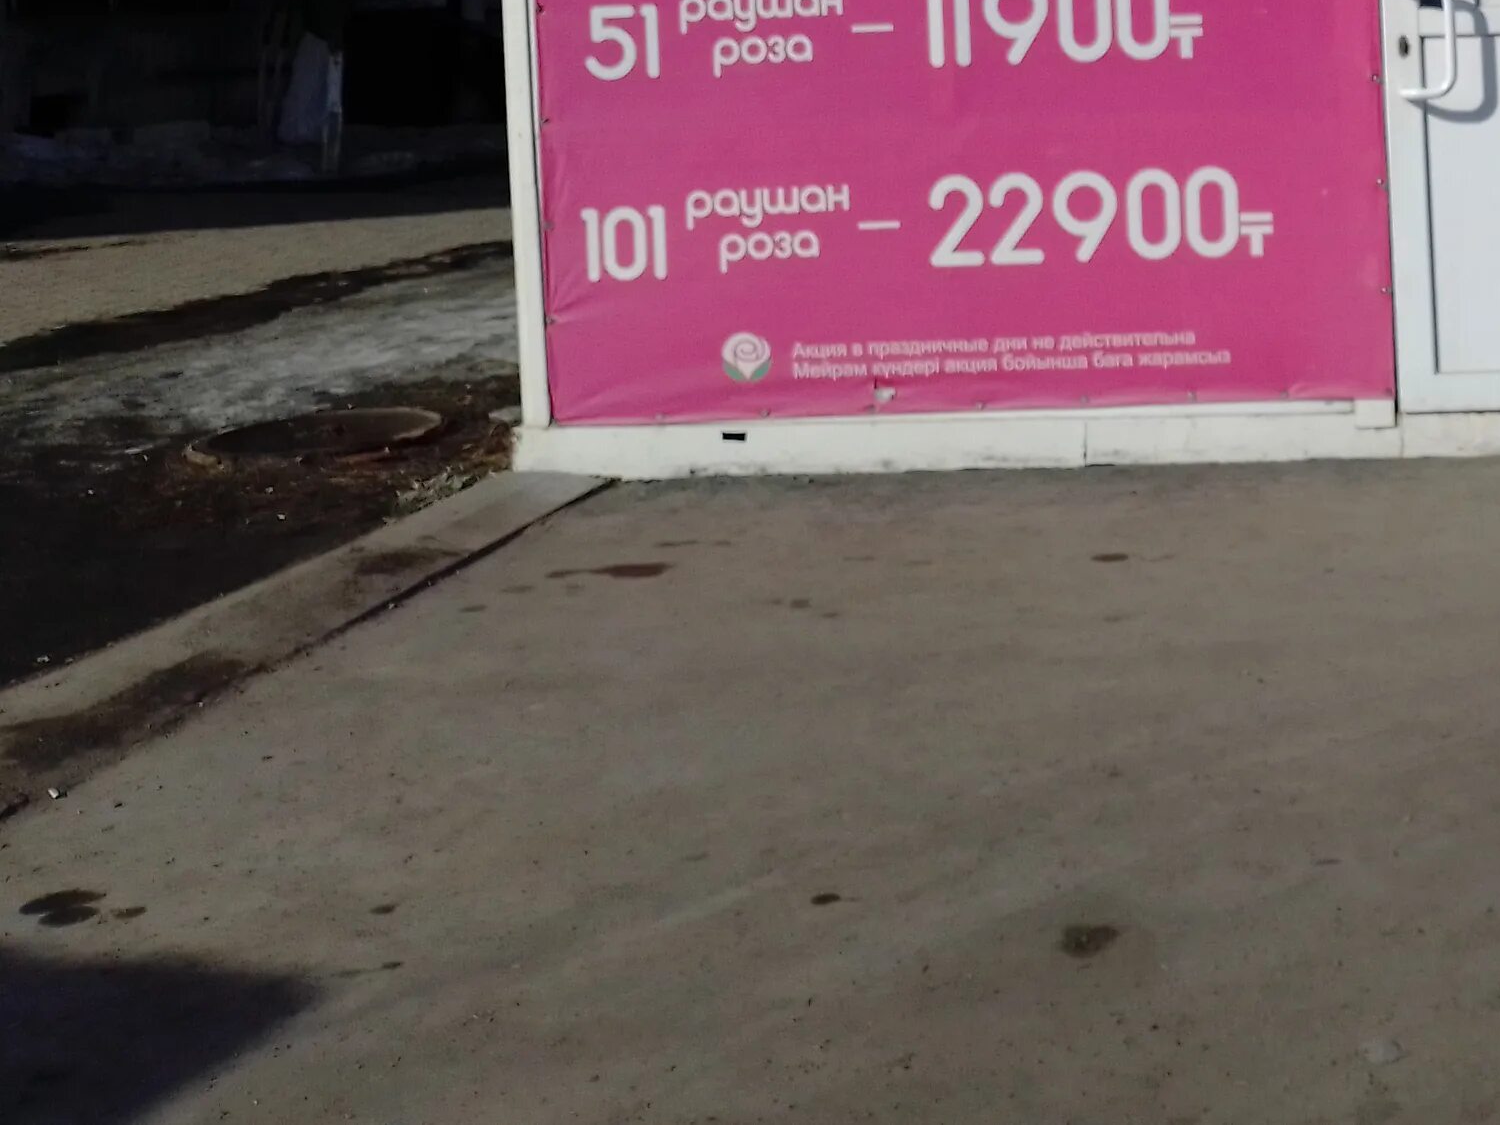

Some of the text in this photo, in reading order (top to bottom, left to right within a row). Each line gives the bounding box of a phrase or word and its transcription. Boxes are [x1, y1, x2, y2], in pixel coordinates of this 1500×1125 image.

[584, 3, 661, 81] 51
[712, 32, 814, 78] роза
[580, 204, 668, 283] 101
[685, 183, 851, 231] раушан
[719, 229, 821, 274] роза
[793, 342, 848, 359] Акция
[867, 338, 989, 360] праздничные
[993, 337, 1028, 354] дни
